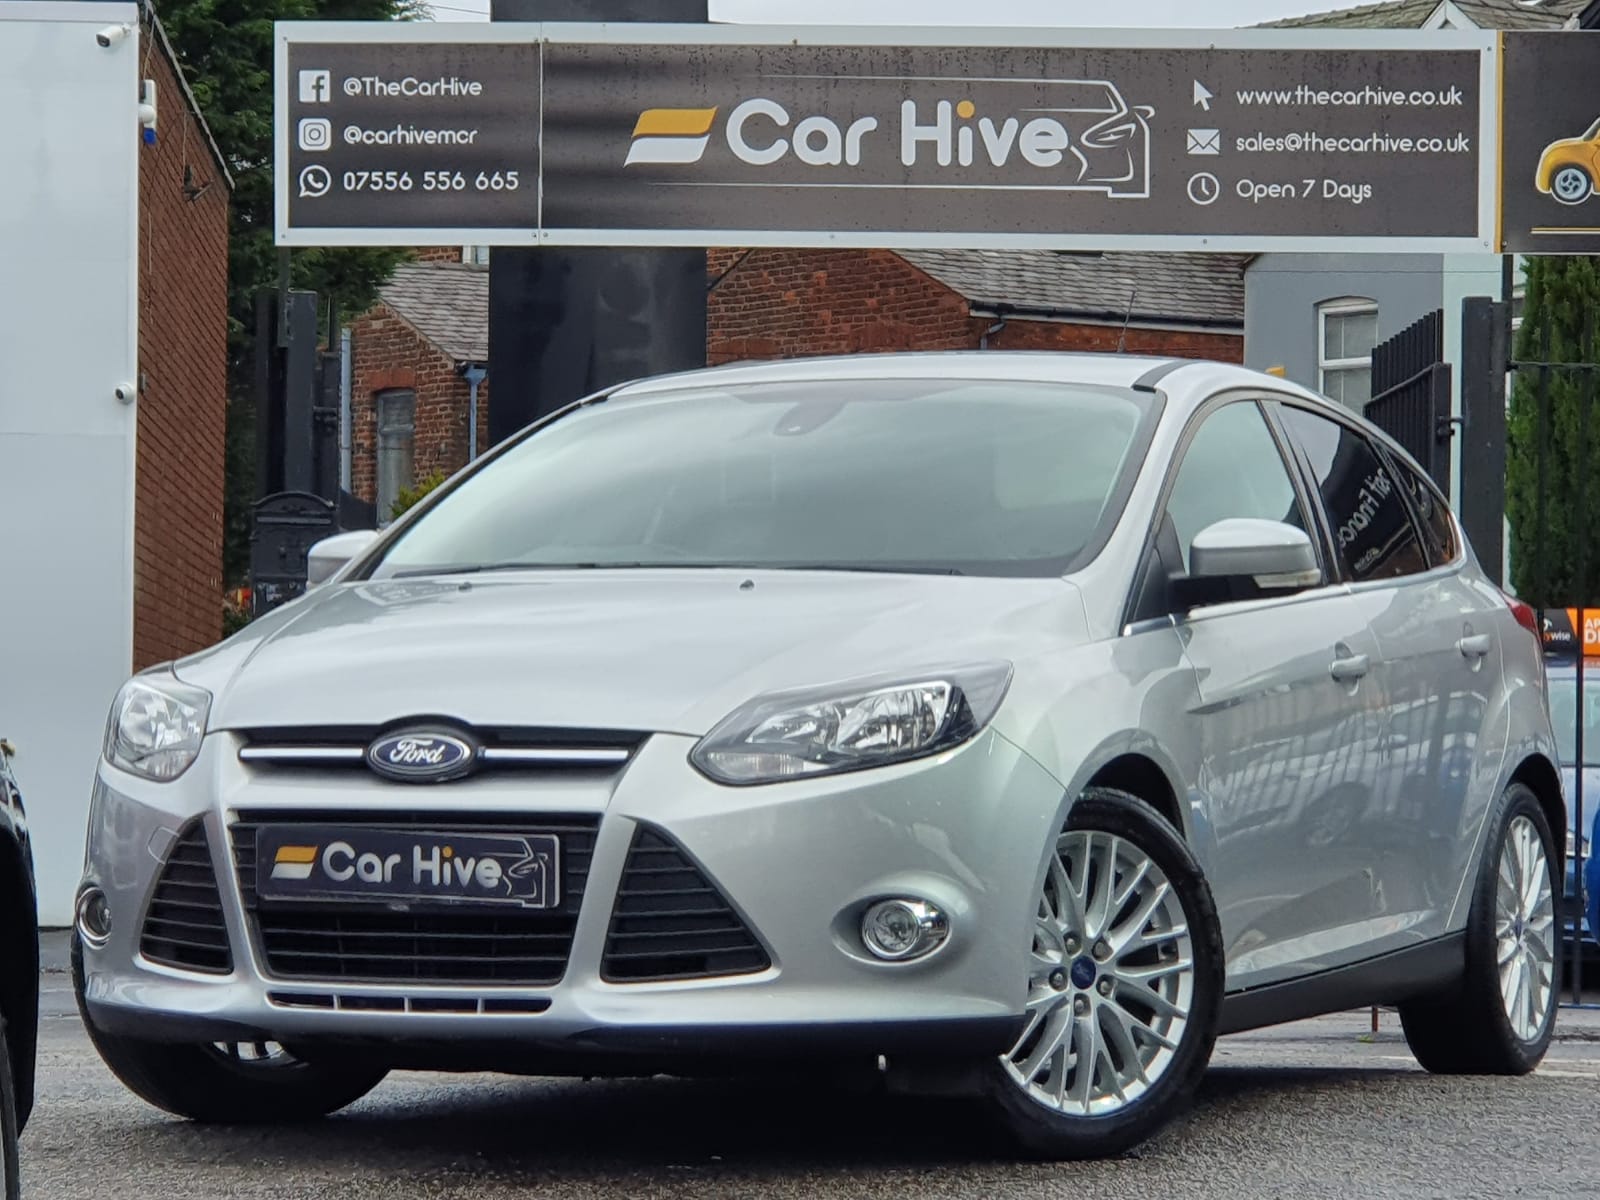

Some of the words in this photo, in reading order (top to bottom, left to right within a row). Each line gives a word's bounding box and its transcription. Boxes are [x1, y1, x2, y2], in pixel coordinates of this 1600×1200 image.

[343, 76, 483, 97] @TheCarHive
[1236, 85, 1463, 106] www.thecarhive.co.uk
[343, 124, 478, 145] @carhivemcr
[725, 98, 878, 166] Car
[900, 99, 1069, 167] Hive
[1236, 132, 1470, 153] sales@thecarhive.co.uk
[343, 171, 414, 191] 07556
[422, 171, 466, 191] 556
[475, 171, 520, 191] 665
[1236, 179, 1296, 203] Open
[1302, 179, 1316, 198] 7
[1323, 179, 1373, 204] Days
[389, 738, 443, 764] Ford
[321, 841, 401, 884] Car
[412, 843, 502, 889] Hive
